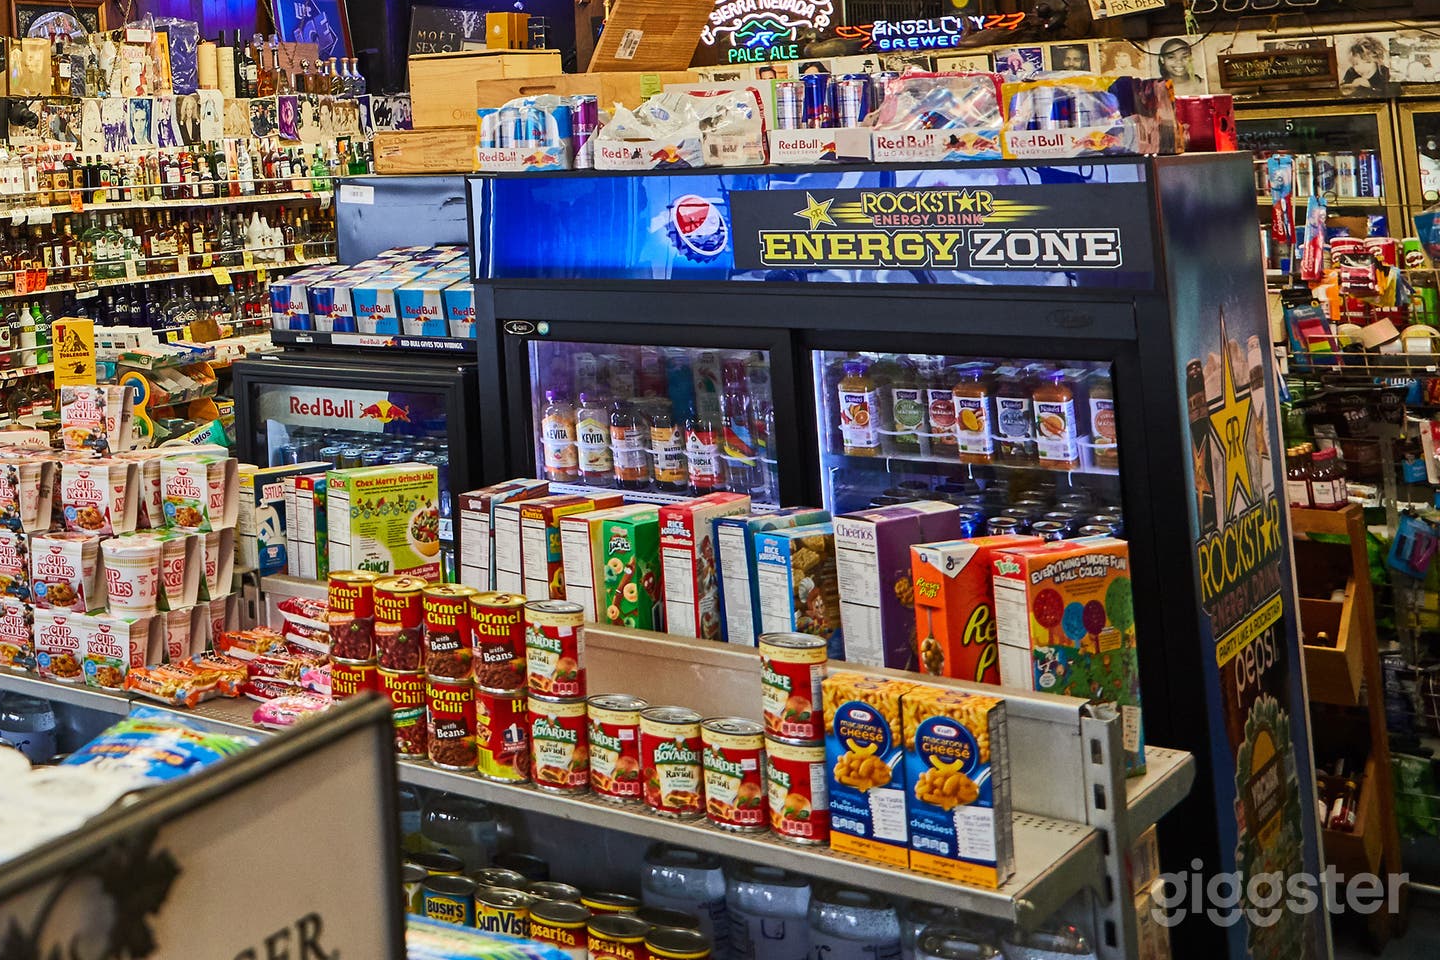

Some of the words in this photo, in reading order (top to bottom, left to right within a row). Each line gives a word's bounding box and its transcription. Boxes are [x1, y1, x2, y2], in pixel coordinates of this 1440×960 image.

[294, 3, 311, 20] Lite
[1110, 0, 1133, 14] FOR
[873, 19, 939, 40] ANGEL
[728, 47, 765, 64] PALE
[769, 44, 799, 61] ALE
[1285, 119, 1294, 131] 5
[778, 139, 799, 150] Red
[800, 139, 819, 150] Bull
[479, 151, 497, 163] Red
[498, 151, 517, 163] Bull
[601, 147, 621, 160] Red
[861, 190, 994, 215] ROCKSTAR
[873, 214, 931, 226] ENERGY
[935, 214, 983, 226] DRINK
[762, 230, 961, 263] ENERGY
[973, 230, 1119, 262] ZONE
[401, 339, 410, 347] RED
[410, 340, 420, 348] BULL
[59, 351, 90, 359] TOBLERONE
[74, 401, 95, 410] CUP
[67, 409, 102, 420] NOODLES
[582, 433, 604, 443] KEVITA
[330, 478, 345, 488] Chex
[355, 478, 374, 488] Chex
[376, 477, 397, 487] Merry
[398, 474, 422, 484] Grinch
[422, 473, 435, 482] Mix
[666, 519, 684, 530] RICE
[661, 527, 691, 539] KRISPIES
[836, 526, 874, 541] Cheerios
[1198, 498, 1282, 603] ROCKSTAR
[995, 557, 1021, 575] Trix
[1030, 555, 1081, 584] EVERYTHING
[1086, 554, 1109, 567] MORE
[1109, 555, 1126, 570] FUN
[1060, 571, 1078, 583] FULL
[1078, 566, 1108, 579] COLOR!
[329, 596, 354, 611] Chili
[471, 605, 521, 624] Hormel
[1219, 639, 1238, 661] PARTY
[1237, 631, 1250, 649] LIKE
[1254, 605, 1281, 636] ROCKSTAR
[431, 640, 459, 651] Beans
[483, 651, 513, 663] Beans
[1235, 625, 1280, 706] pepsi
[840, 719, 876, 733] macaroni
[532, 724, 577, 743] BOYARDEE
[540, 745, 566, 756] Ravioli
[666, 769, 694, 779] Ravioli
[830, 800, 870, 817] cheesiest
[910, 820, 954, 835] cheesiest
[427, 900, 464, 918] BUSH'S
